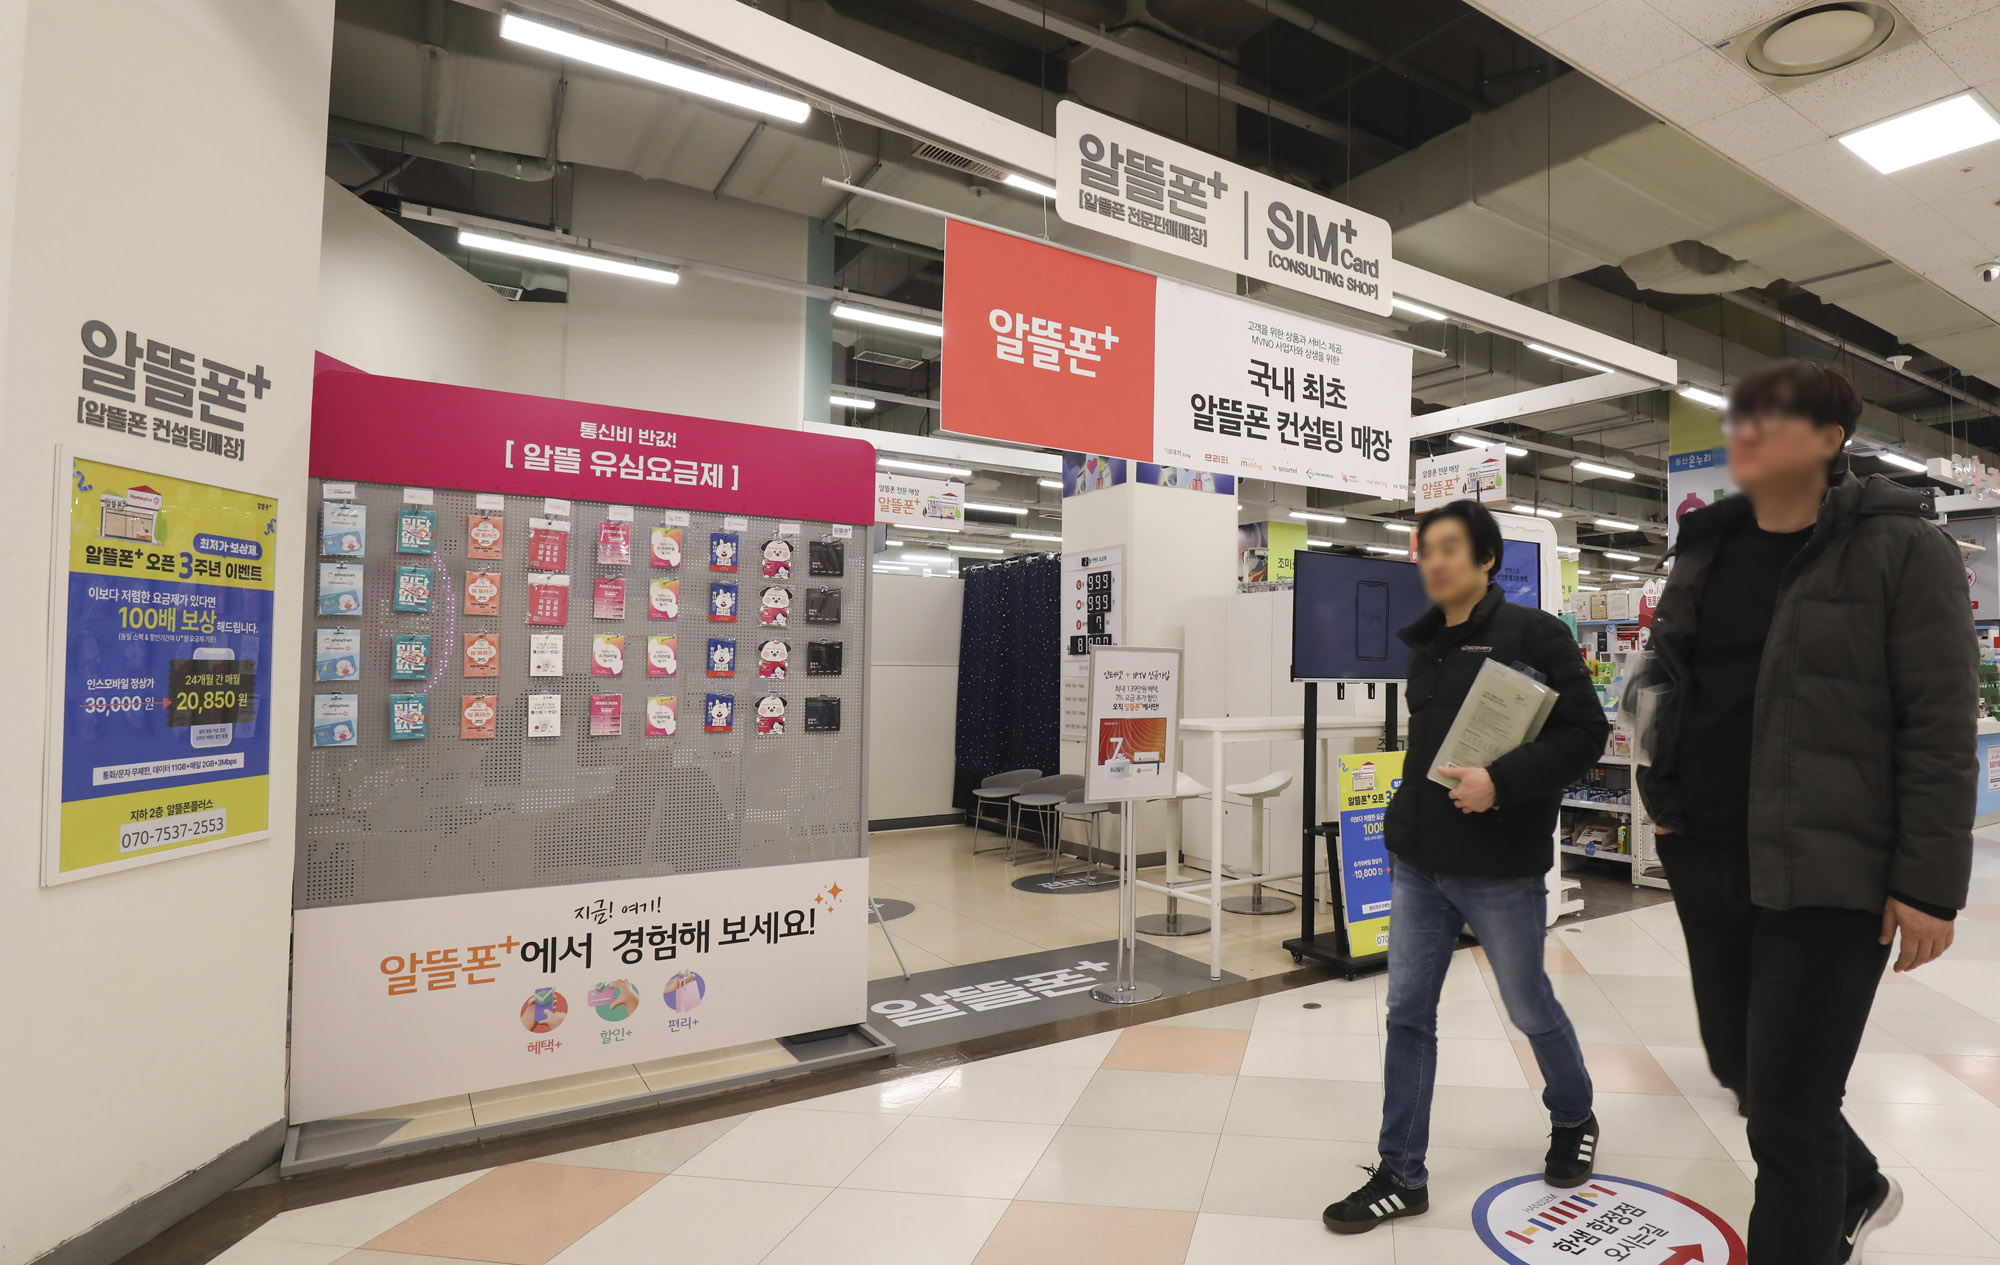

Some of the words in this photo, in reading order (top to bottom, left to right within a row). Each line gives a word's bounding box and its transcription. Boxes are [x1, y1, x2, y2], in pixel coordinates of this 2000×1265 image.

[1079, 133, 1229, 224] 알뜰폰+
[1079, 189, 1126, 221] [알뜰폰
[1128, 204, 1208, 248] 전문판매매장]
[1266, 201, 1358, 266] SIM+
[1340, 249, 1380, 279] Card
[1268, 250, 1345, 289] [CONSULTING
[1346, 278, 1379, 300] SHOP]
[988, 308, 1120, 378] 알뜰폰+
[1248, 321, 1268, 336] 고객을
[1270, 327, 1284, 338] 위한
[1285, 330, 1306, 345] 상품과
[1308, 336, 1327, 350] 서비스
[1252, 335, 1274, 349] MVNO
[1275, 341, 1304, 357] 사업자와
[1304, 348, 1324, 362] 상생을
[1326, 353, 1340, 366] 위한
[81, 319, 272, 432] 알뜰폰+
[1248, 358, 1295, 403] 국내
[1302, 372, 1348, 410] 최초
[77, 396, 148, 438] [알뜰폰
[152, 416, 245, 462] 컨설팅매장]
[579, 421, 634, 444] 통신비
[638, 427, 678, 450] 반값!
[1190, 393, 1270, 441] 알뜰폰
[1277, 411, 1344, 454] 컨설팅
[1351, 426, 1392, 462] 매장
[524, 442, 581, 474] 알뜰
[590, 451, 724, 491] 유심요금제
[1422, 475, 1461, 500] 알뜰폰+
[878, 496, 921, 516] 알뜰폰+
[200, 537, 228, 552] 최저가
[86, 545, 144, 569] 알뜰폰+
[146, 552, 176, 573] 오픈
[178, 552, 222, 579] 3주년
[225, 562, 262, 582] 이벤트
[1088, 574, 1108, 590] 999
[88, 587, 120, 602] 이보다
[121, 589, 151, 604] 저렴한
[152, 592, 189, 607] 요금제가
[190, 596, 217, 609] 있다면
[1088, 594, 1108, 611] 999
[118, 606, 176, 632] 100배
[86, 678, 130, 690] 인스모바일
[130, 678, 154, 690] 정상가
[185, 674, 214, 686] 24개월
[216, 674, 224, 686] 간
[225, 674, 240, 686] 매월
[85, 695, 142, 717] 39,000
[144, 697, 154, 711] 원
[176, 690, 236, 715] 20,850
[238, 692, 248, 707] 원
[102, 768, 131, 781] 통화/문자
[132, 766, 152, 778] 무제한,
[152, 764, 171, 774] 데이터
[172, 760, 201, 773] 11GB+매일
[202, 758, 238, 769] 2GB+3Mbps
[130, 808, 148, 821] 지하
[150, 807, 164, 819] 2층
[166, 799, 214, 816] 알뜰폰플러스
[1348, 794, 1371, 806] 알뜰폰+
[1372, 794, 1384, 804] 오픈
[122, 817, 224, 849] 070-7537-2553
[1354, 868, 1378, 880] 19,800
[574, 898, 614, 925] 지금!
[621, 896, 662, 917] 여기!
[612, 918, 711, 966] 경험해
[718, 908, 816, 947] 보세요!
[870, 959, 1112, 1028] 알뜰폰+
[599, 1026, 634, 1046] 할인+
[667, 1014, 700, 1032] 편리+
[526, 1038, 563, 1056] 혜택+
[1522, 1192, 1560, 1214] HANSSEM
[1552, 1228, 1602, 1256] 한샘
[1586, 1202, 1648, 1234] 합정점
[1604, 1222, 1671, 1262] 오시는길
